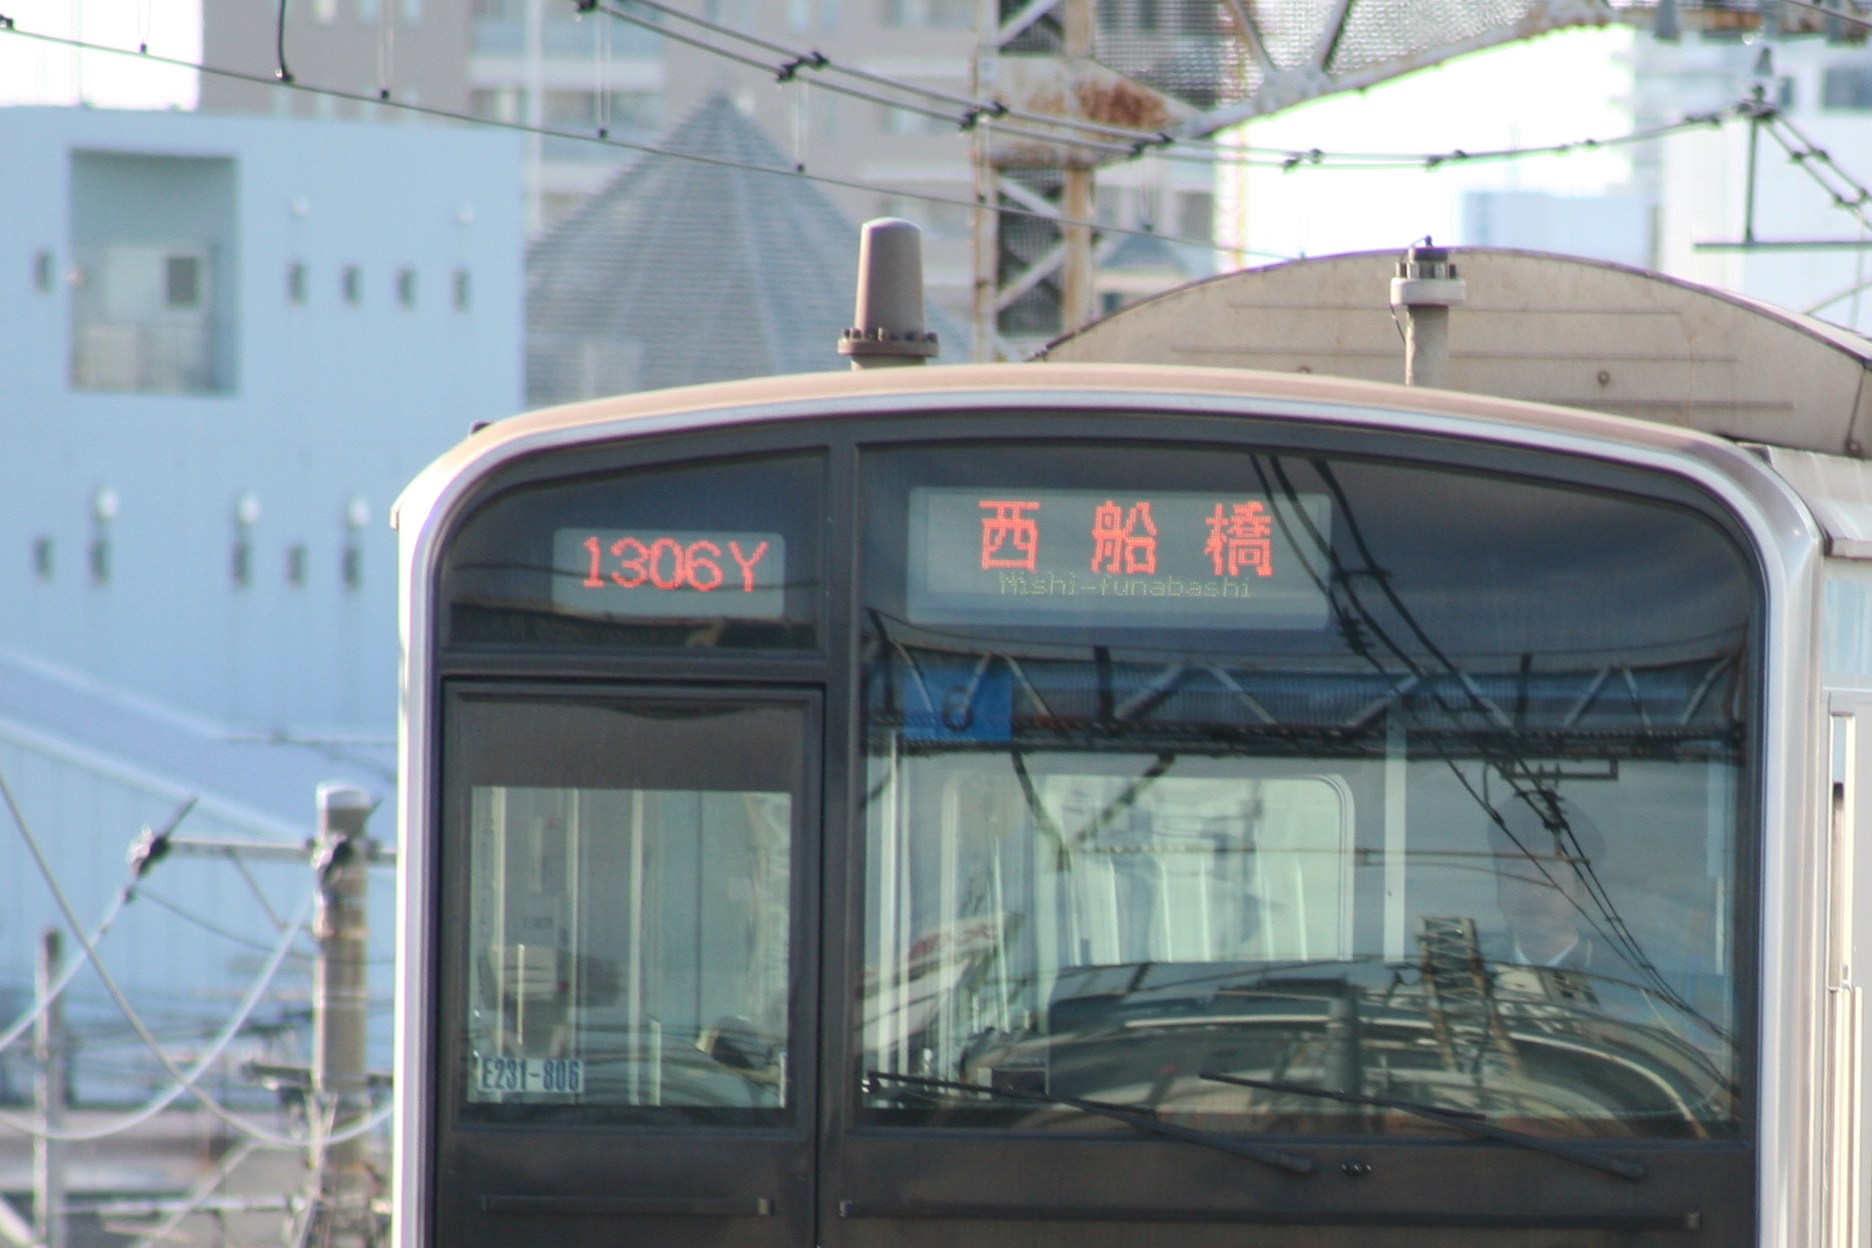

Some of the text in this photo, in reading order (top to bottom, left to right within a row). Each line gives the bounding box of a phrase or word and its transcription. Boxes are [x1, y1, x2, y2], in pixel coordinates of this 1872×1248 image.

[582, 535, 770, 593] 1306Y
[979, 499, 1274, 577] 西船橋
[481, 1057, 581, 1093] E231-806
